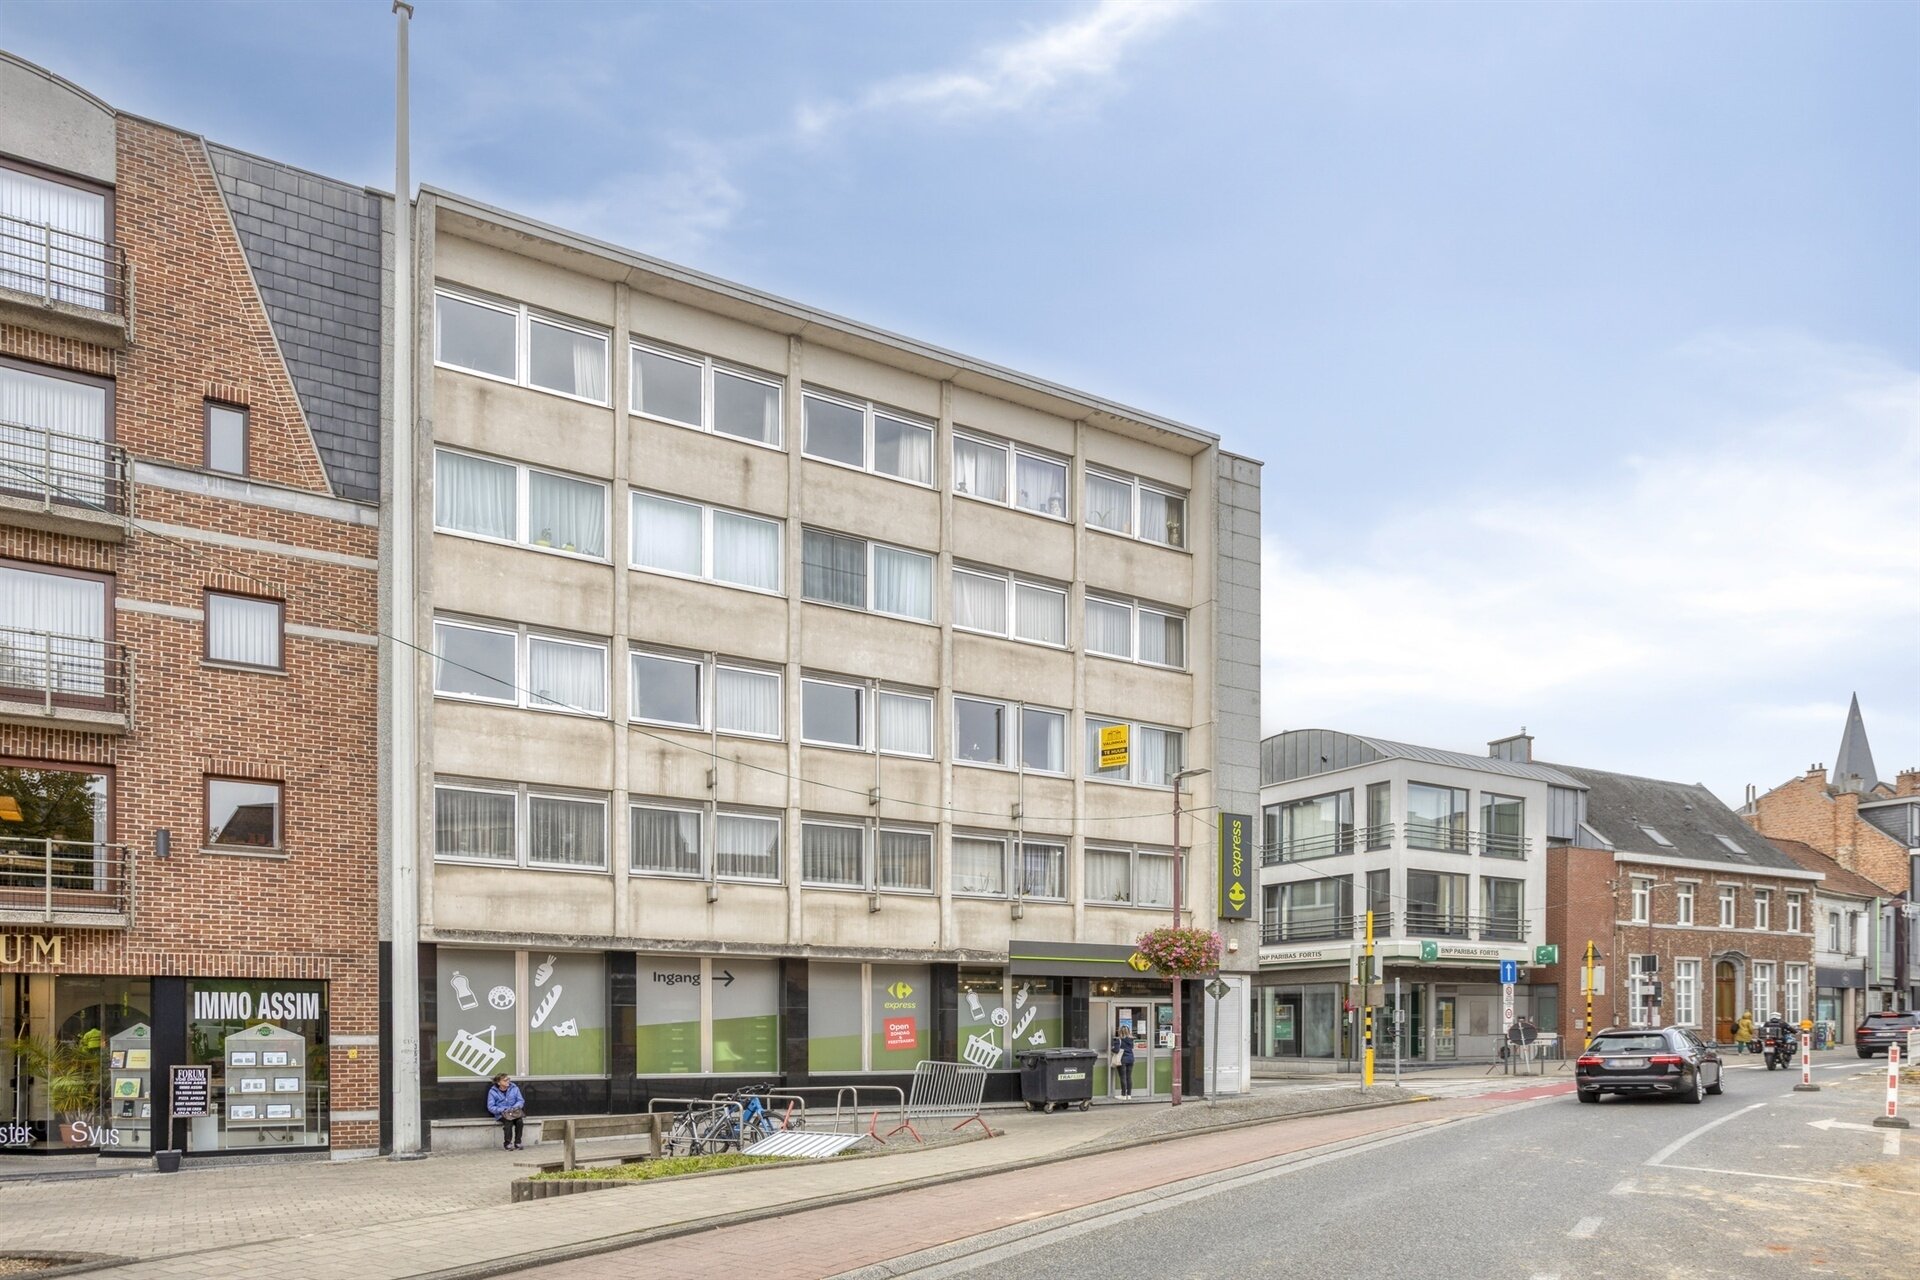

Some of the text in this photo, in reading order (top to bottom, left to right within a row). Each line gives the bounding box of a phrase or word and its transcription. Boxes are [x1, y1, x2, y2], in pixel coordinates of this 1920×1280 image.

[1232, 820, 1243, 877] express
[653, 971, 701, 986] Ingang
[194, 991, 319, 1020] IMMO ASSIM
[884, 1002, 916, 1010] express
[889, 1023, 909, 1032] Open
[178, 1069, 205, 1078] FORUM
[71, 1121, 120, 1147] Syus
